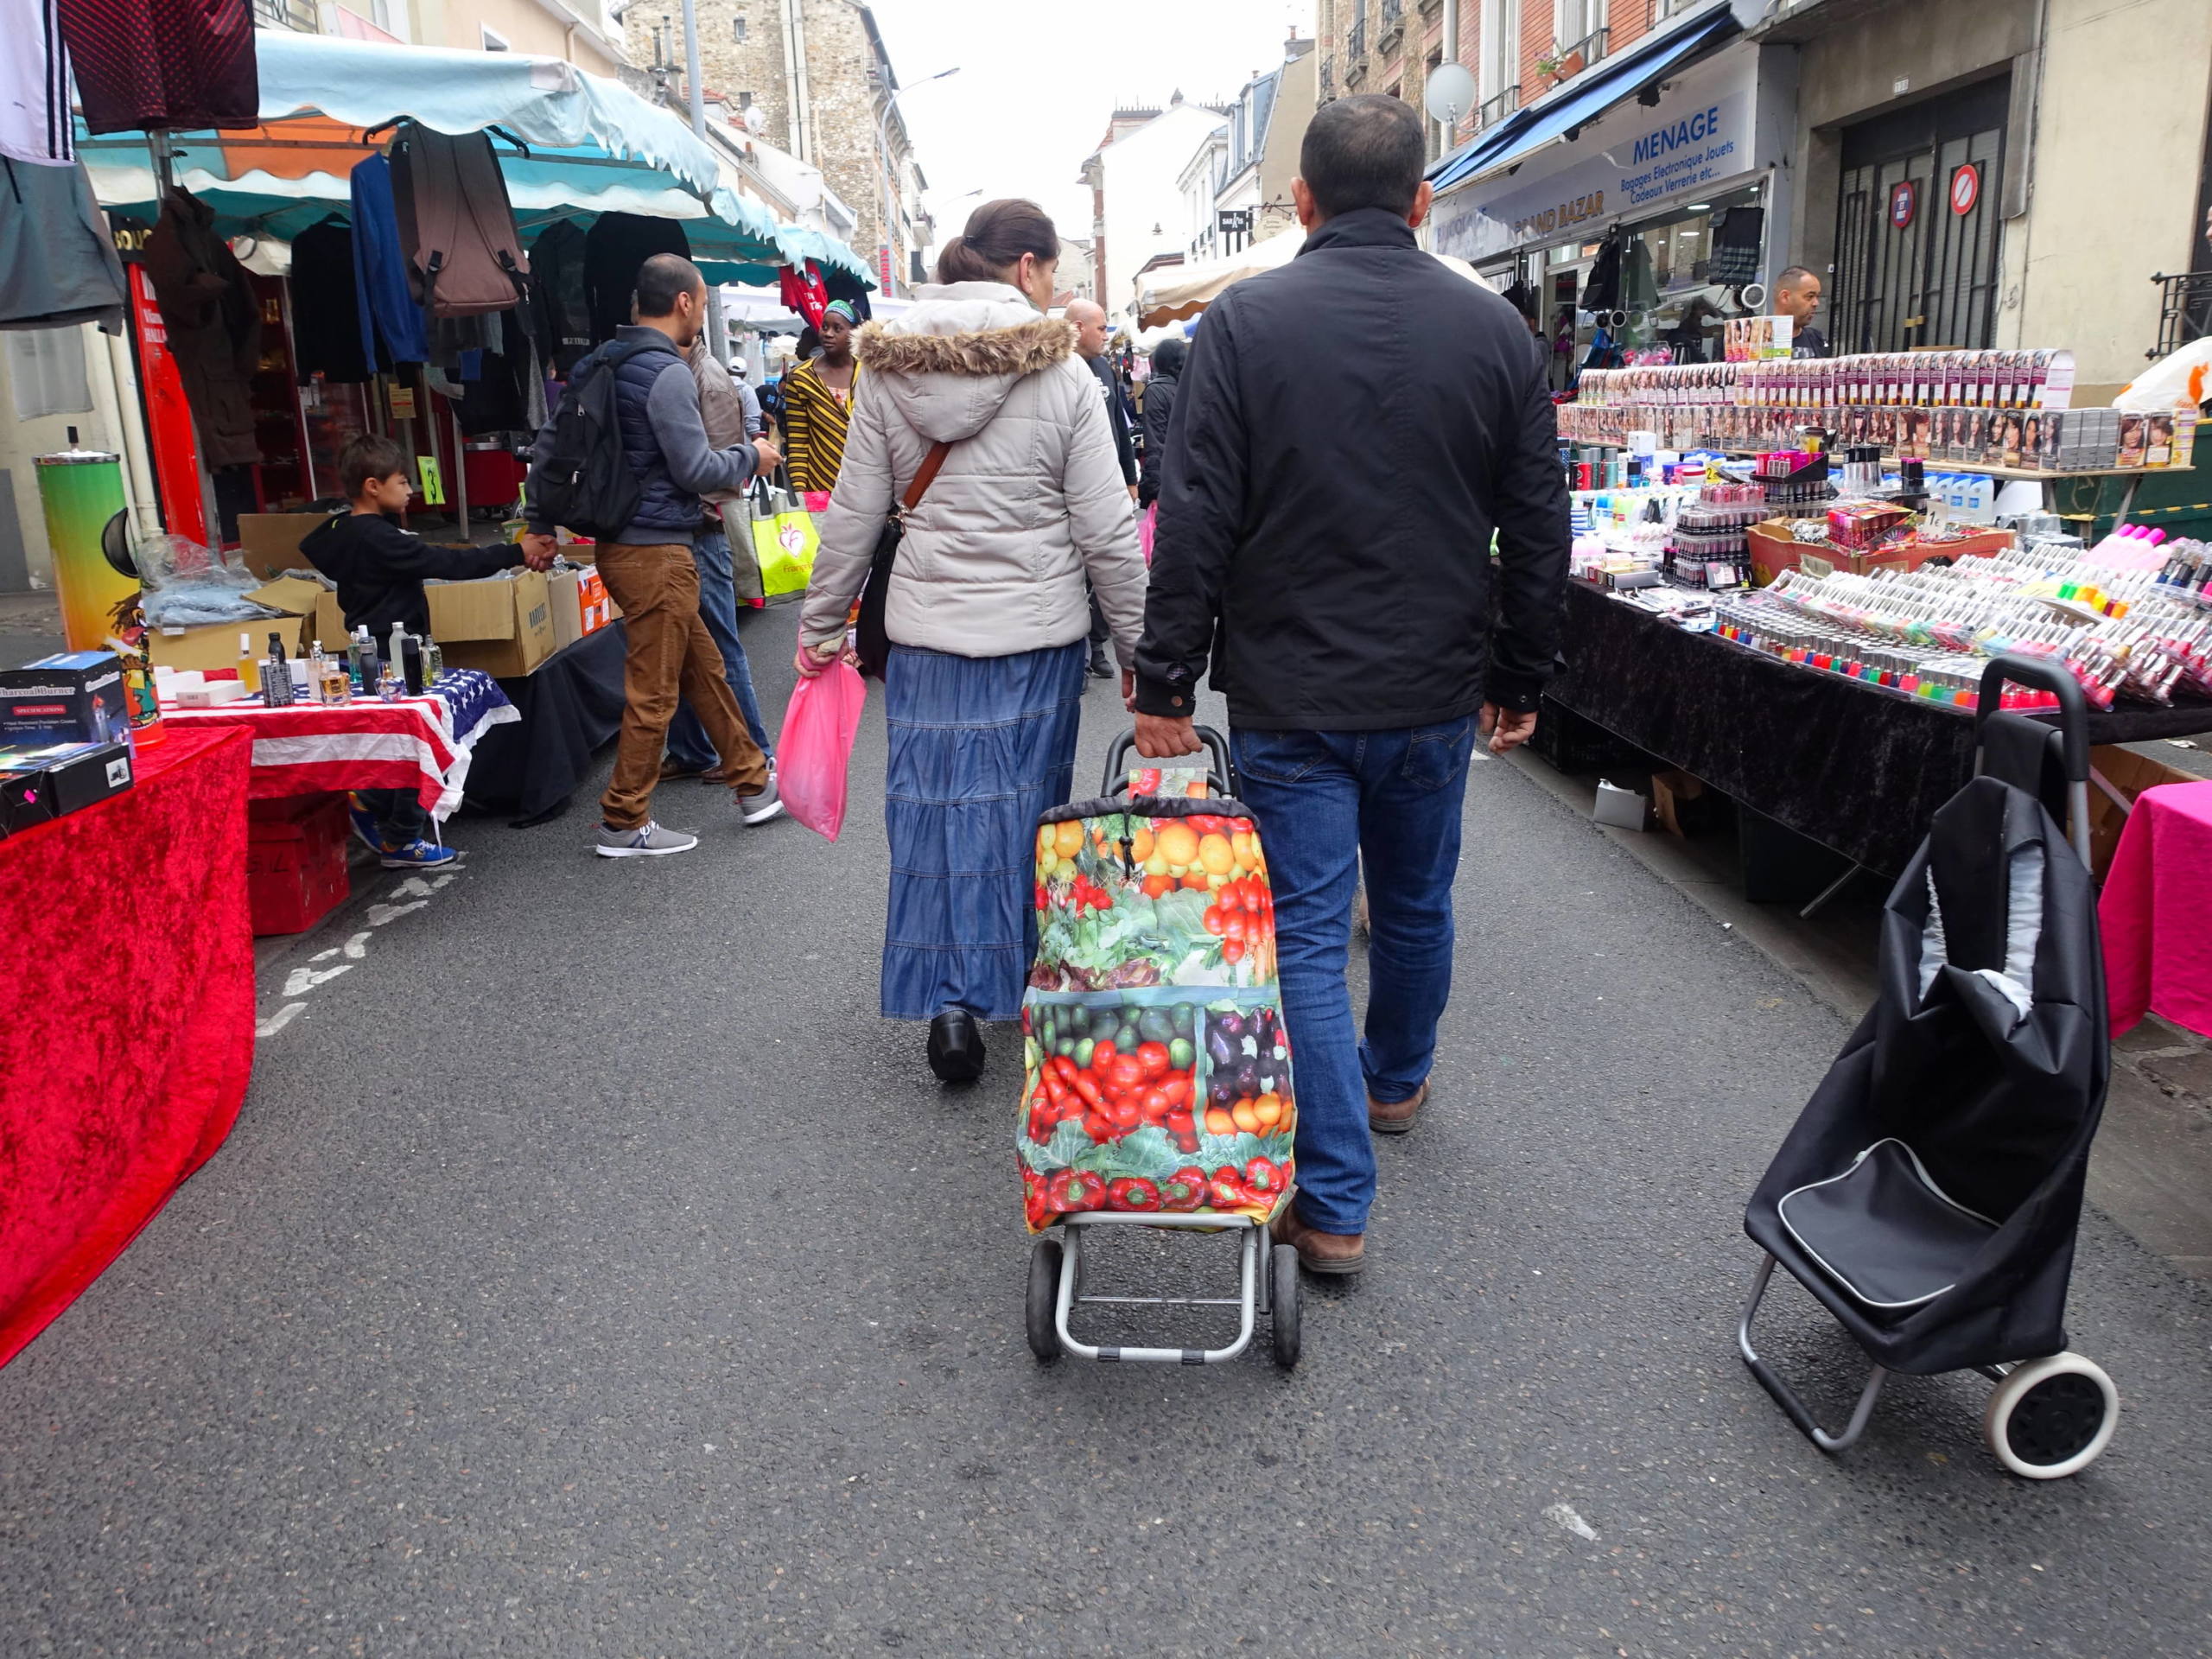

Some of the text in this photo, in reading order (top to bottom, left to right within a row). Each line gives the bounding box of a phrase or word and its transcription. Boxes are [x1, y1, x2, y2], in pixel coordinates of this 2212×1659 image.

[1633, 106, 1719, 166] MENAGE
[1620, 140, 1735, 194] Bagages Electronique Jouets
[1630, 181, 1662, 205] Cadeaux
[1665, 173, 1697, 193] Verrerie
[1558, 191, 1605, 229] BAZAR
